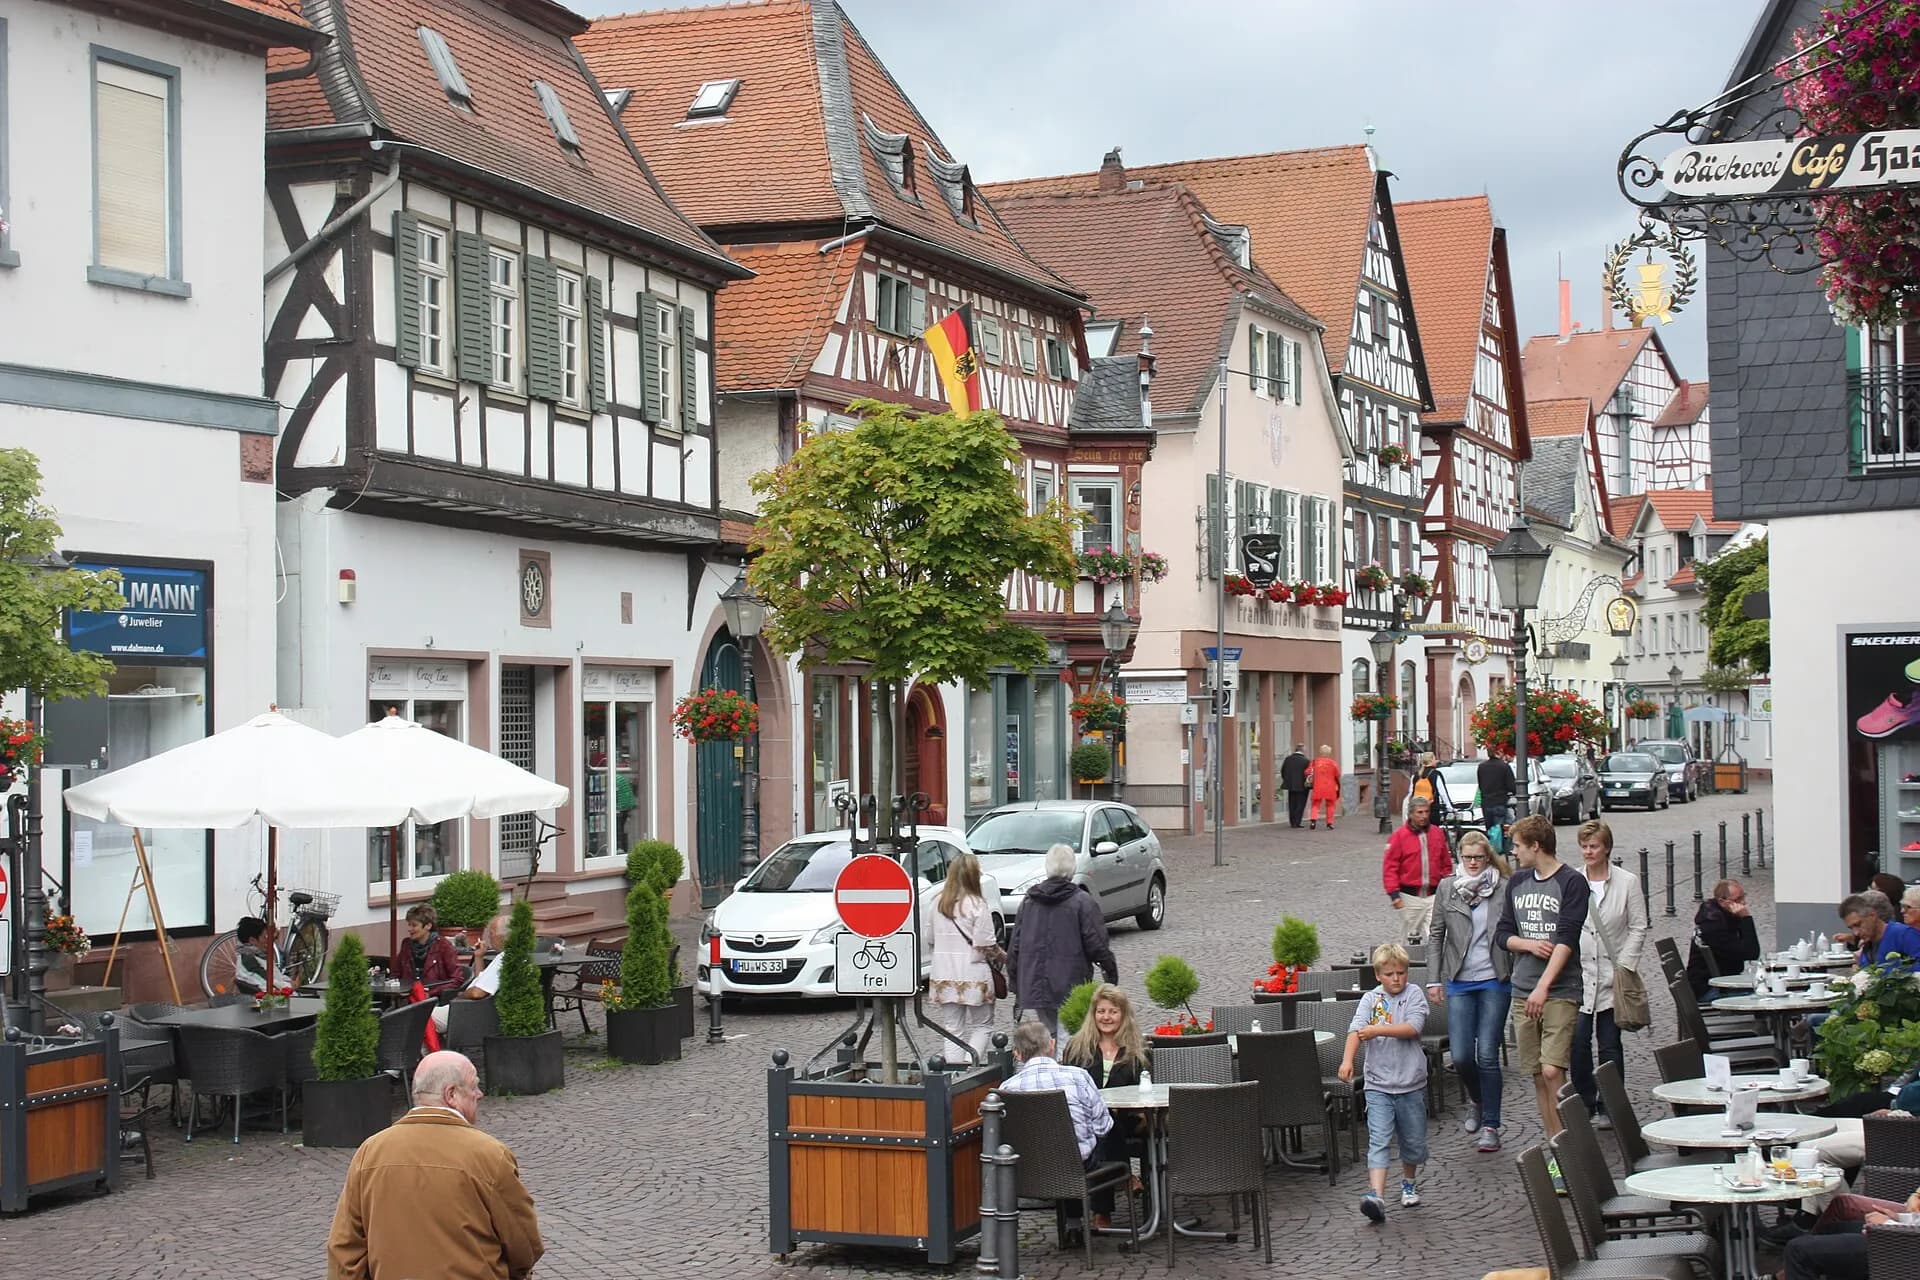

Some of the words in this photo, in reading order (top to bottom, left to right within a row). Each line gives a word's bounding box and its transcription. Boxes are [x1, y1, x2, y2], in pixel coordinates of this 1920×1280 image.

[1674, 151, 1782, 184] Bäckerei
[1791, 143, 1846, 188] Cafe
[108, 581, 195, 611] LMANN
[129, 616, 163, 628] Juwelier
[111, 644, 164, 653] www.dalmann.de
[1514, 892, 1560, 914] WOLVES
[1544, 922, 1556, 932] CO
[738, 961, 750, 972] HU
[755, 961, 768, 972] WS
[769, 961, 782, 972] 33
[863, 973, 888, 987] frei
